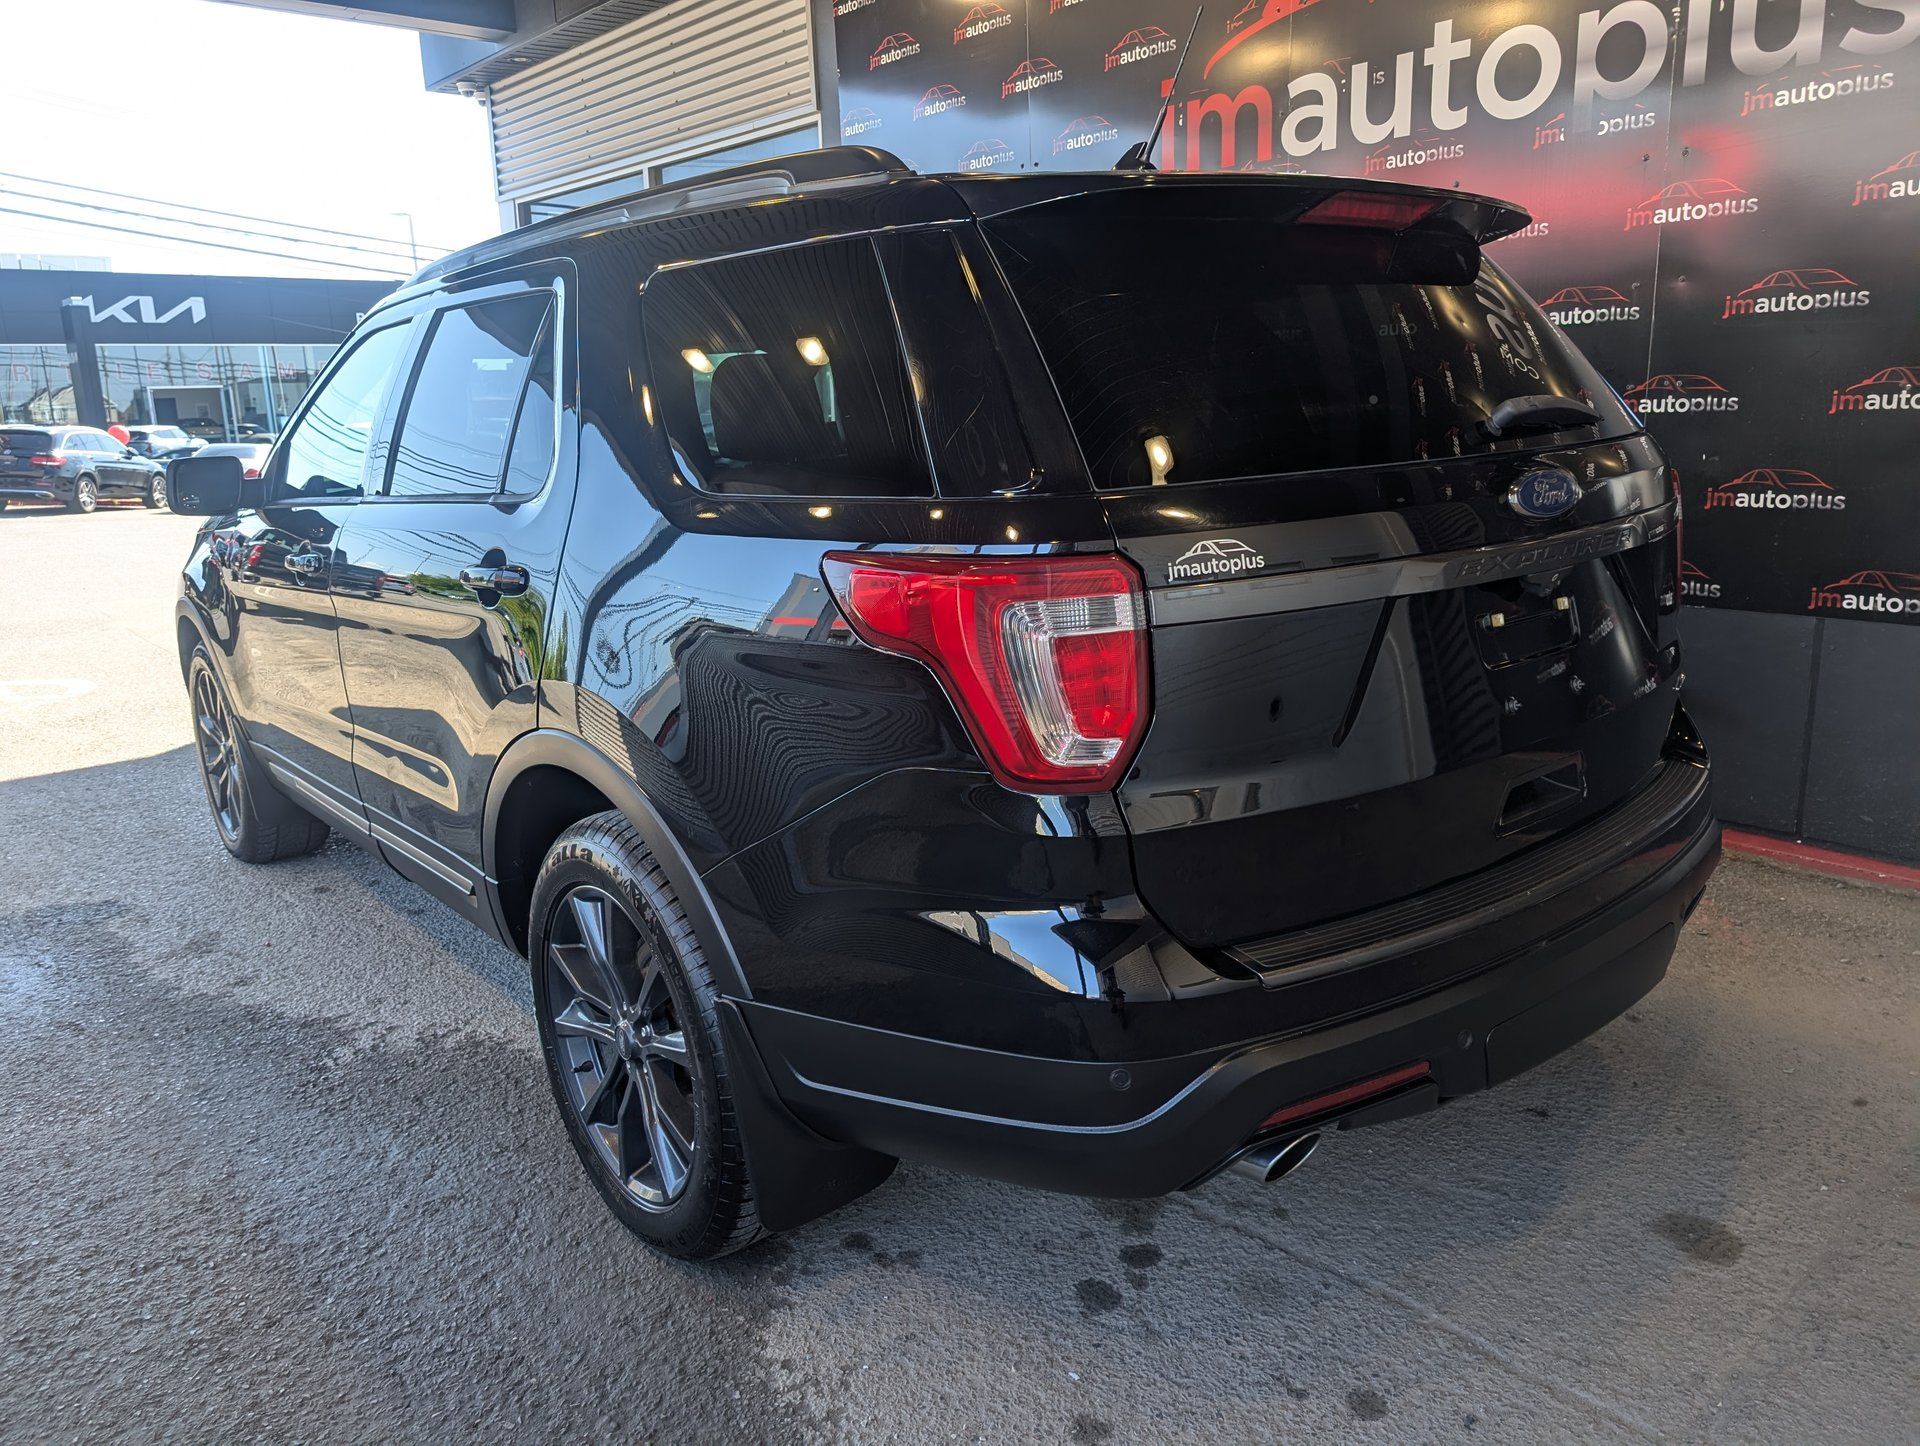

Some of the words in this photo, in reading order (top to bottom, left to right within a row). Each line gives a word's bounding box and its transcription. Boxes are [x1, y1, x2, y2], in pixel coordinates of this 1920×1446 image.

[953, 13, 1012, 45] jmautoplus
[869, 42, 921, 71] jmautoplus
[1104, 39, 1177, 72] jmautoplus
[1001, 69, 1063, 99] jmautoplus
[1741, 72, 1894, 117] jmautoplus
[913, 95, 966, 121] jmautoplus
[1052, 128, 1118, 155] jmautoplus
[1363, 144, 1464, 176] jmautoplus
[1623, 197, 1759, 231] jmautoplus
[80, 295, 207, 324] KIA
[1722, 288, 1870, 319] jmautoplus
[1624, 394, 1739, 413] mautoplus
[1532, 477, 1570, 507] Ford
[1704, 487, 1846, 510] jmautoplus
[1167, 553, 1265, 582] jmautoplus
